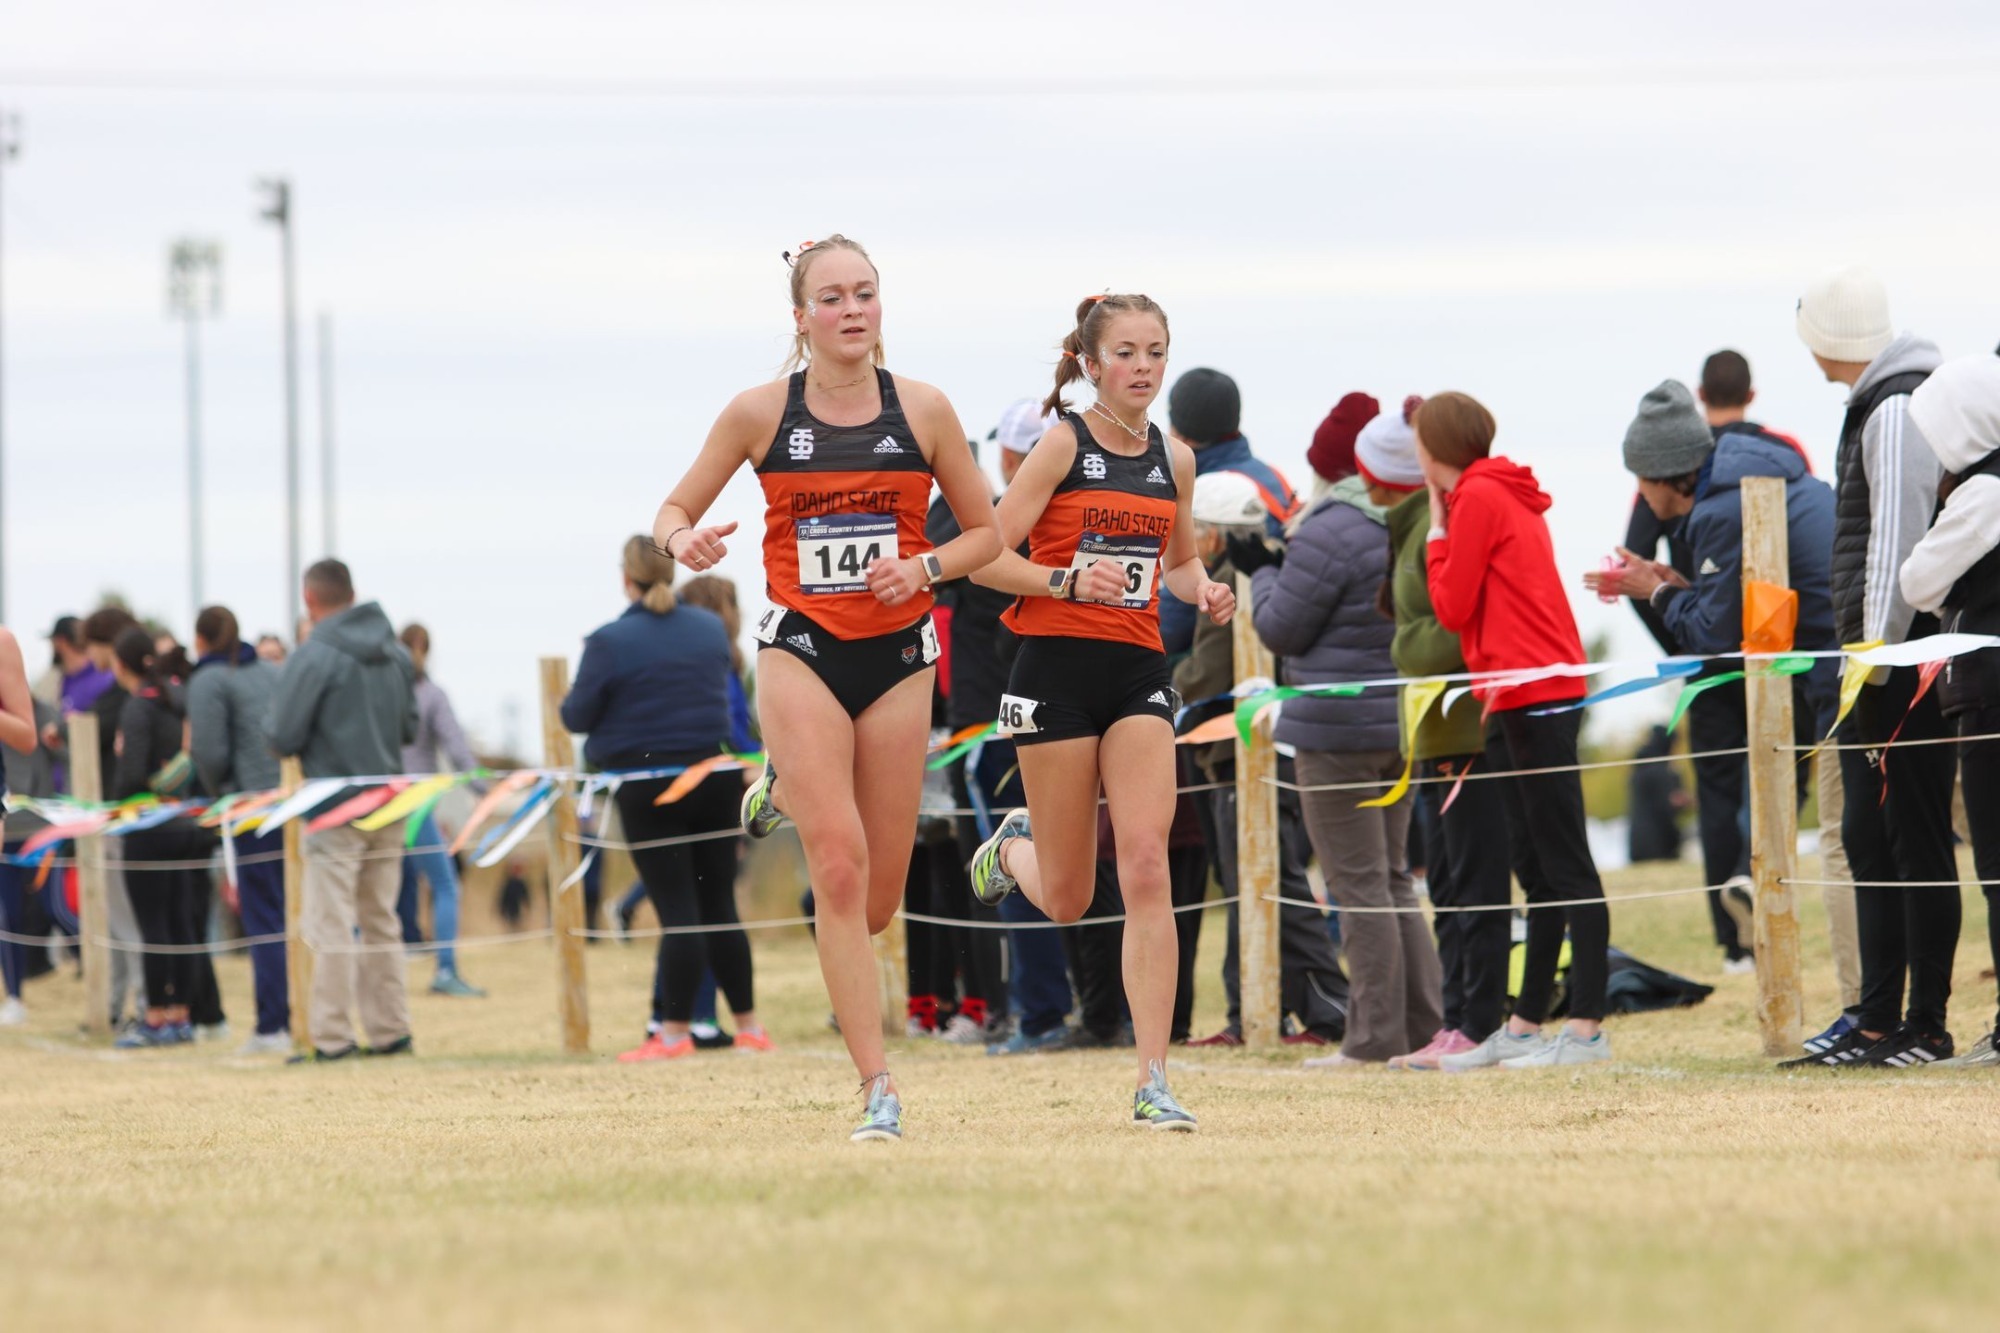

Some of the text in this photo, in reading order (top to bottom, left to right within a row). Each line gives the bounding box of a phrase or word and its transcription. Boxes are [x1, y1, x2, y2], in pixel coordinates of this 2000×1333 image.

[873, 446, 904, 454] adidas
[1146, 475, 1167, 485] adidas
[791, 490, 901, 513] IDAHO STATE
[828, 526, 853, 534] COUNTRY
[853, 522, 897, 532] CHAMPIONSHIPS
[1083, 507, 1170, 537] IDAHO STATE
[786, 636, 818, 657] adidas
[1000, 702, 1023, 728] 46
